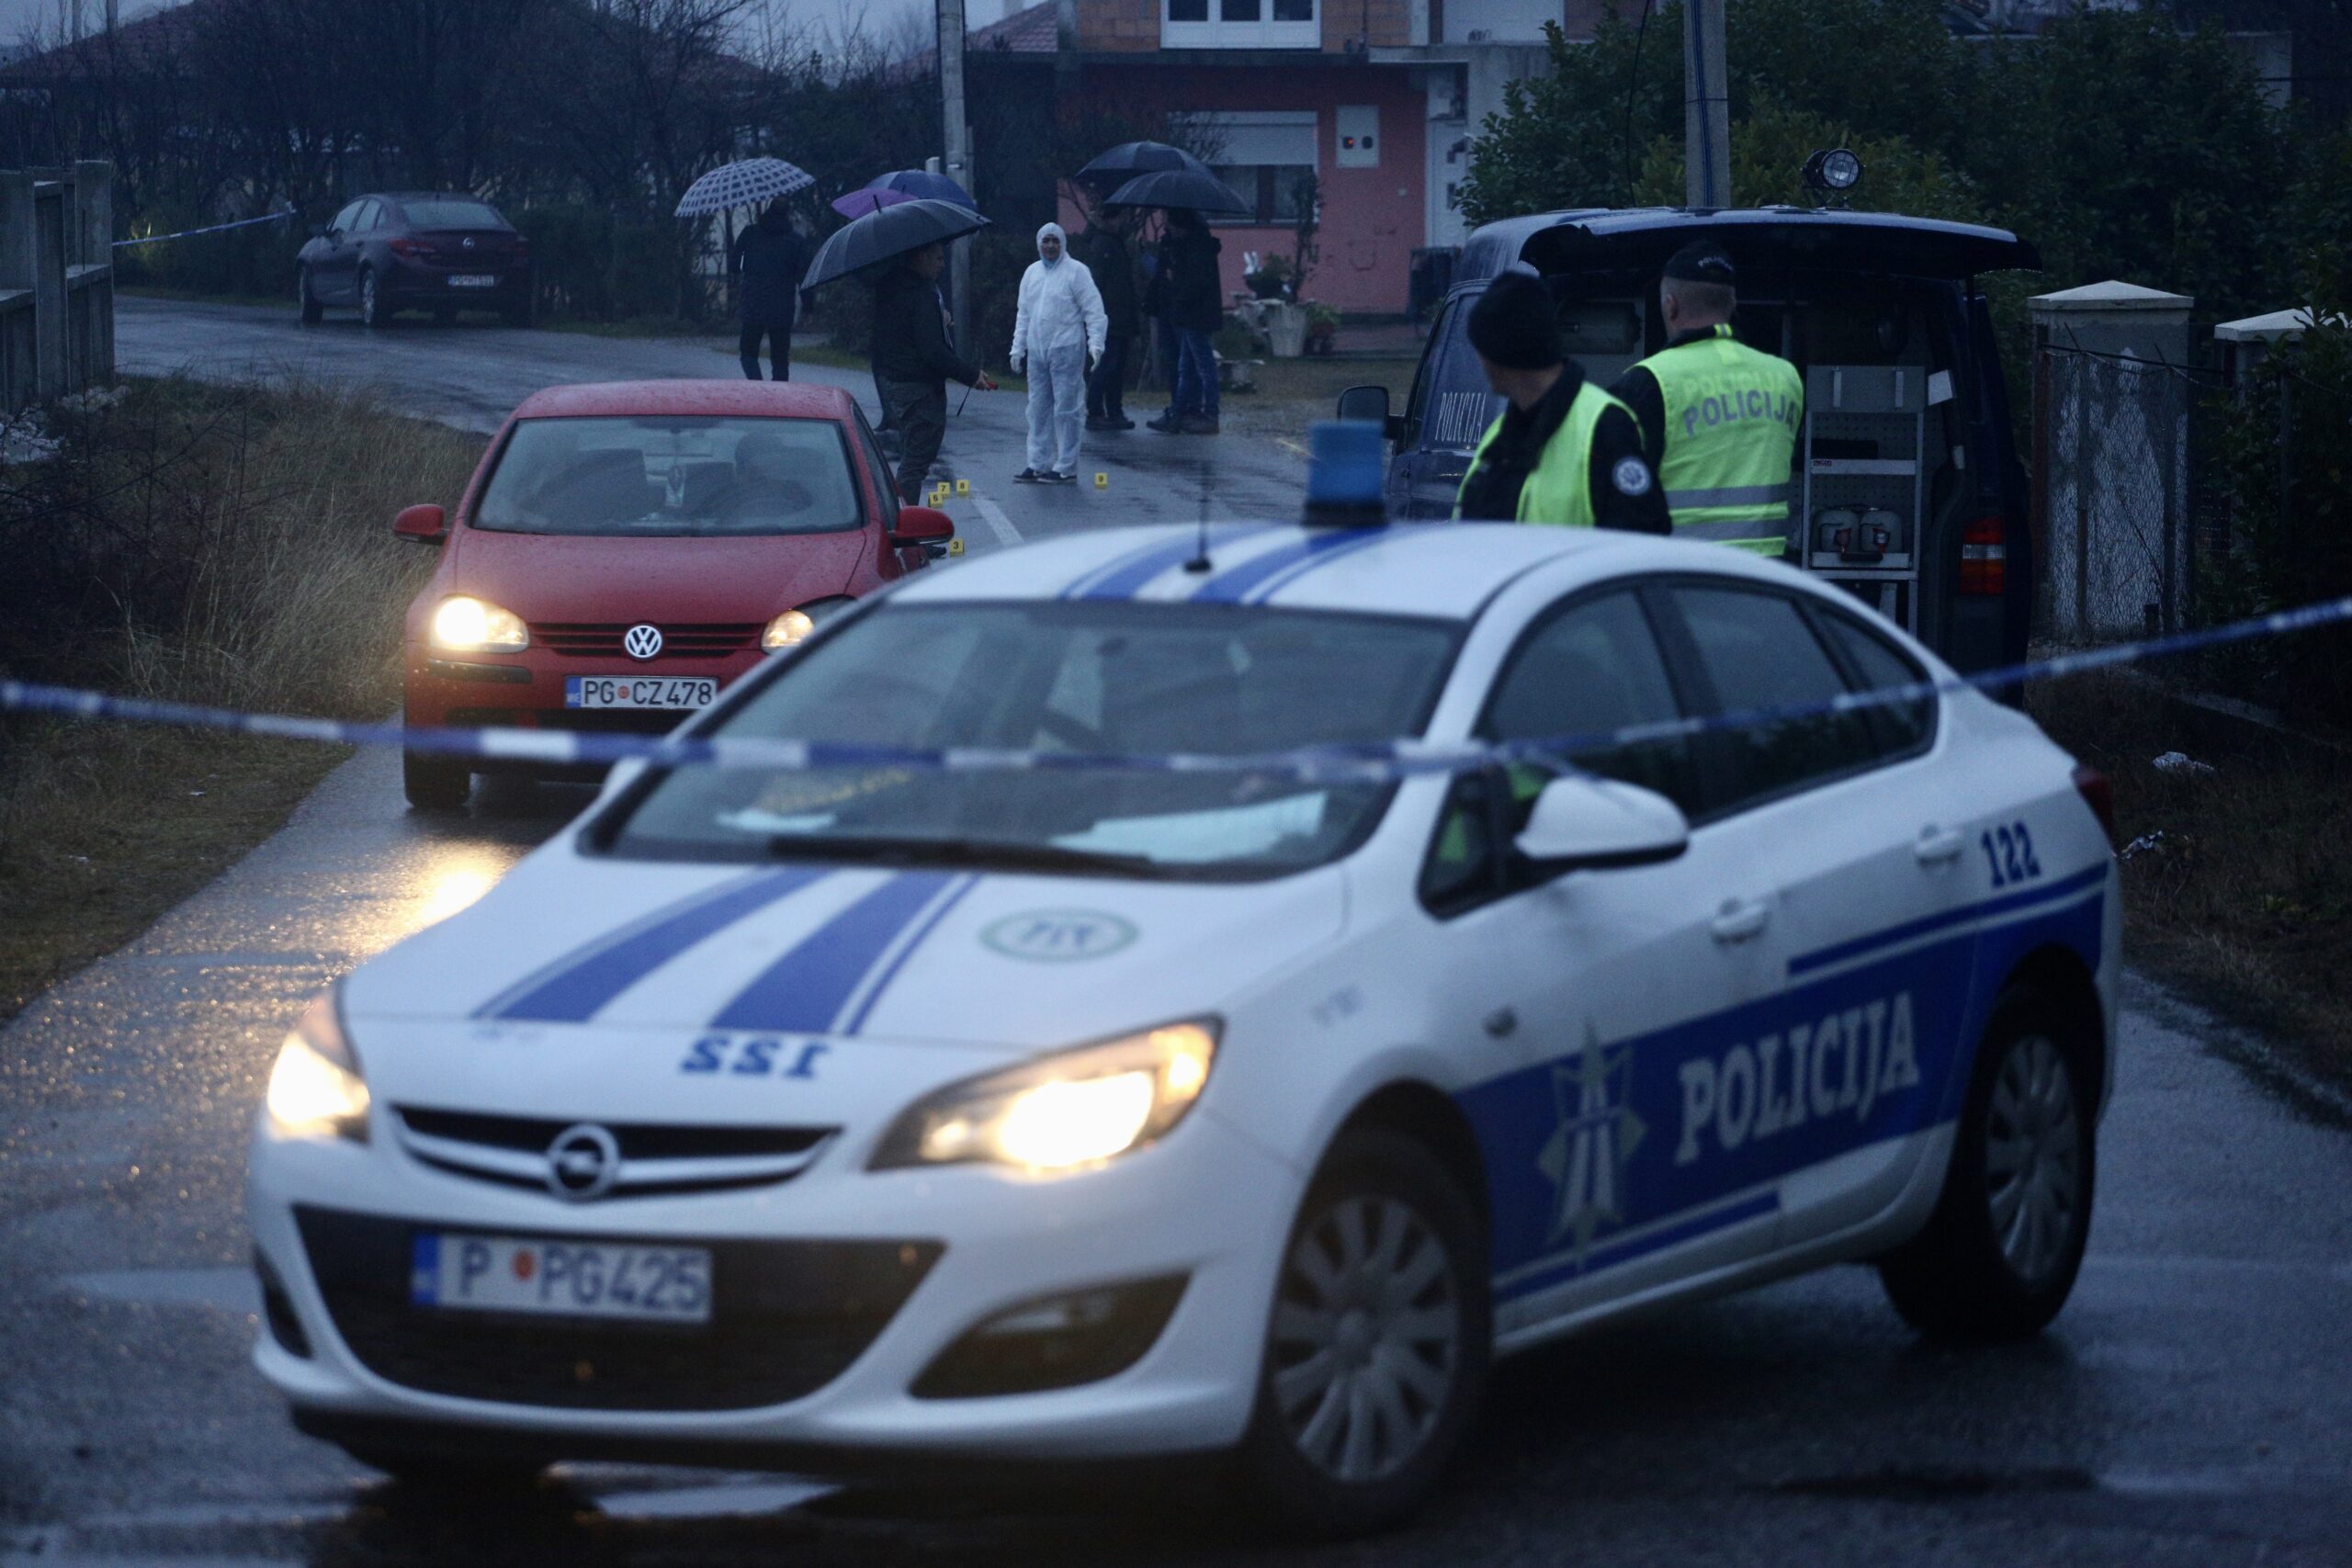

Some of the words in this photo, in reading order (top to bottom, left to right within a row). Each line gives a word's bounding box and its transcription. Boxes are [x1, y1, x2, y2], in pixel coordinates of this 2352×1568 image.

[1434, 391, 1487, 443] POLICIJA
[1683, 389, 1797, 438] POLICIJA
[584, 681, 615, 705] PG
[633, 681, 712, 705] CZ478
[1980, 821, 2041, 886] 122
[1674, 989, 1920, 1167] POLICIJA
